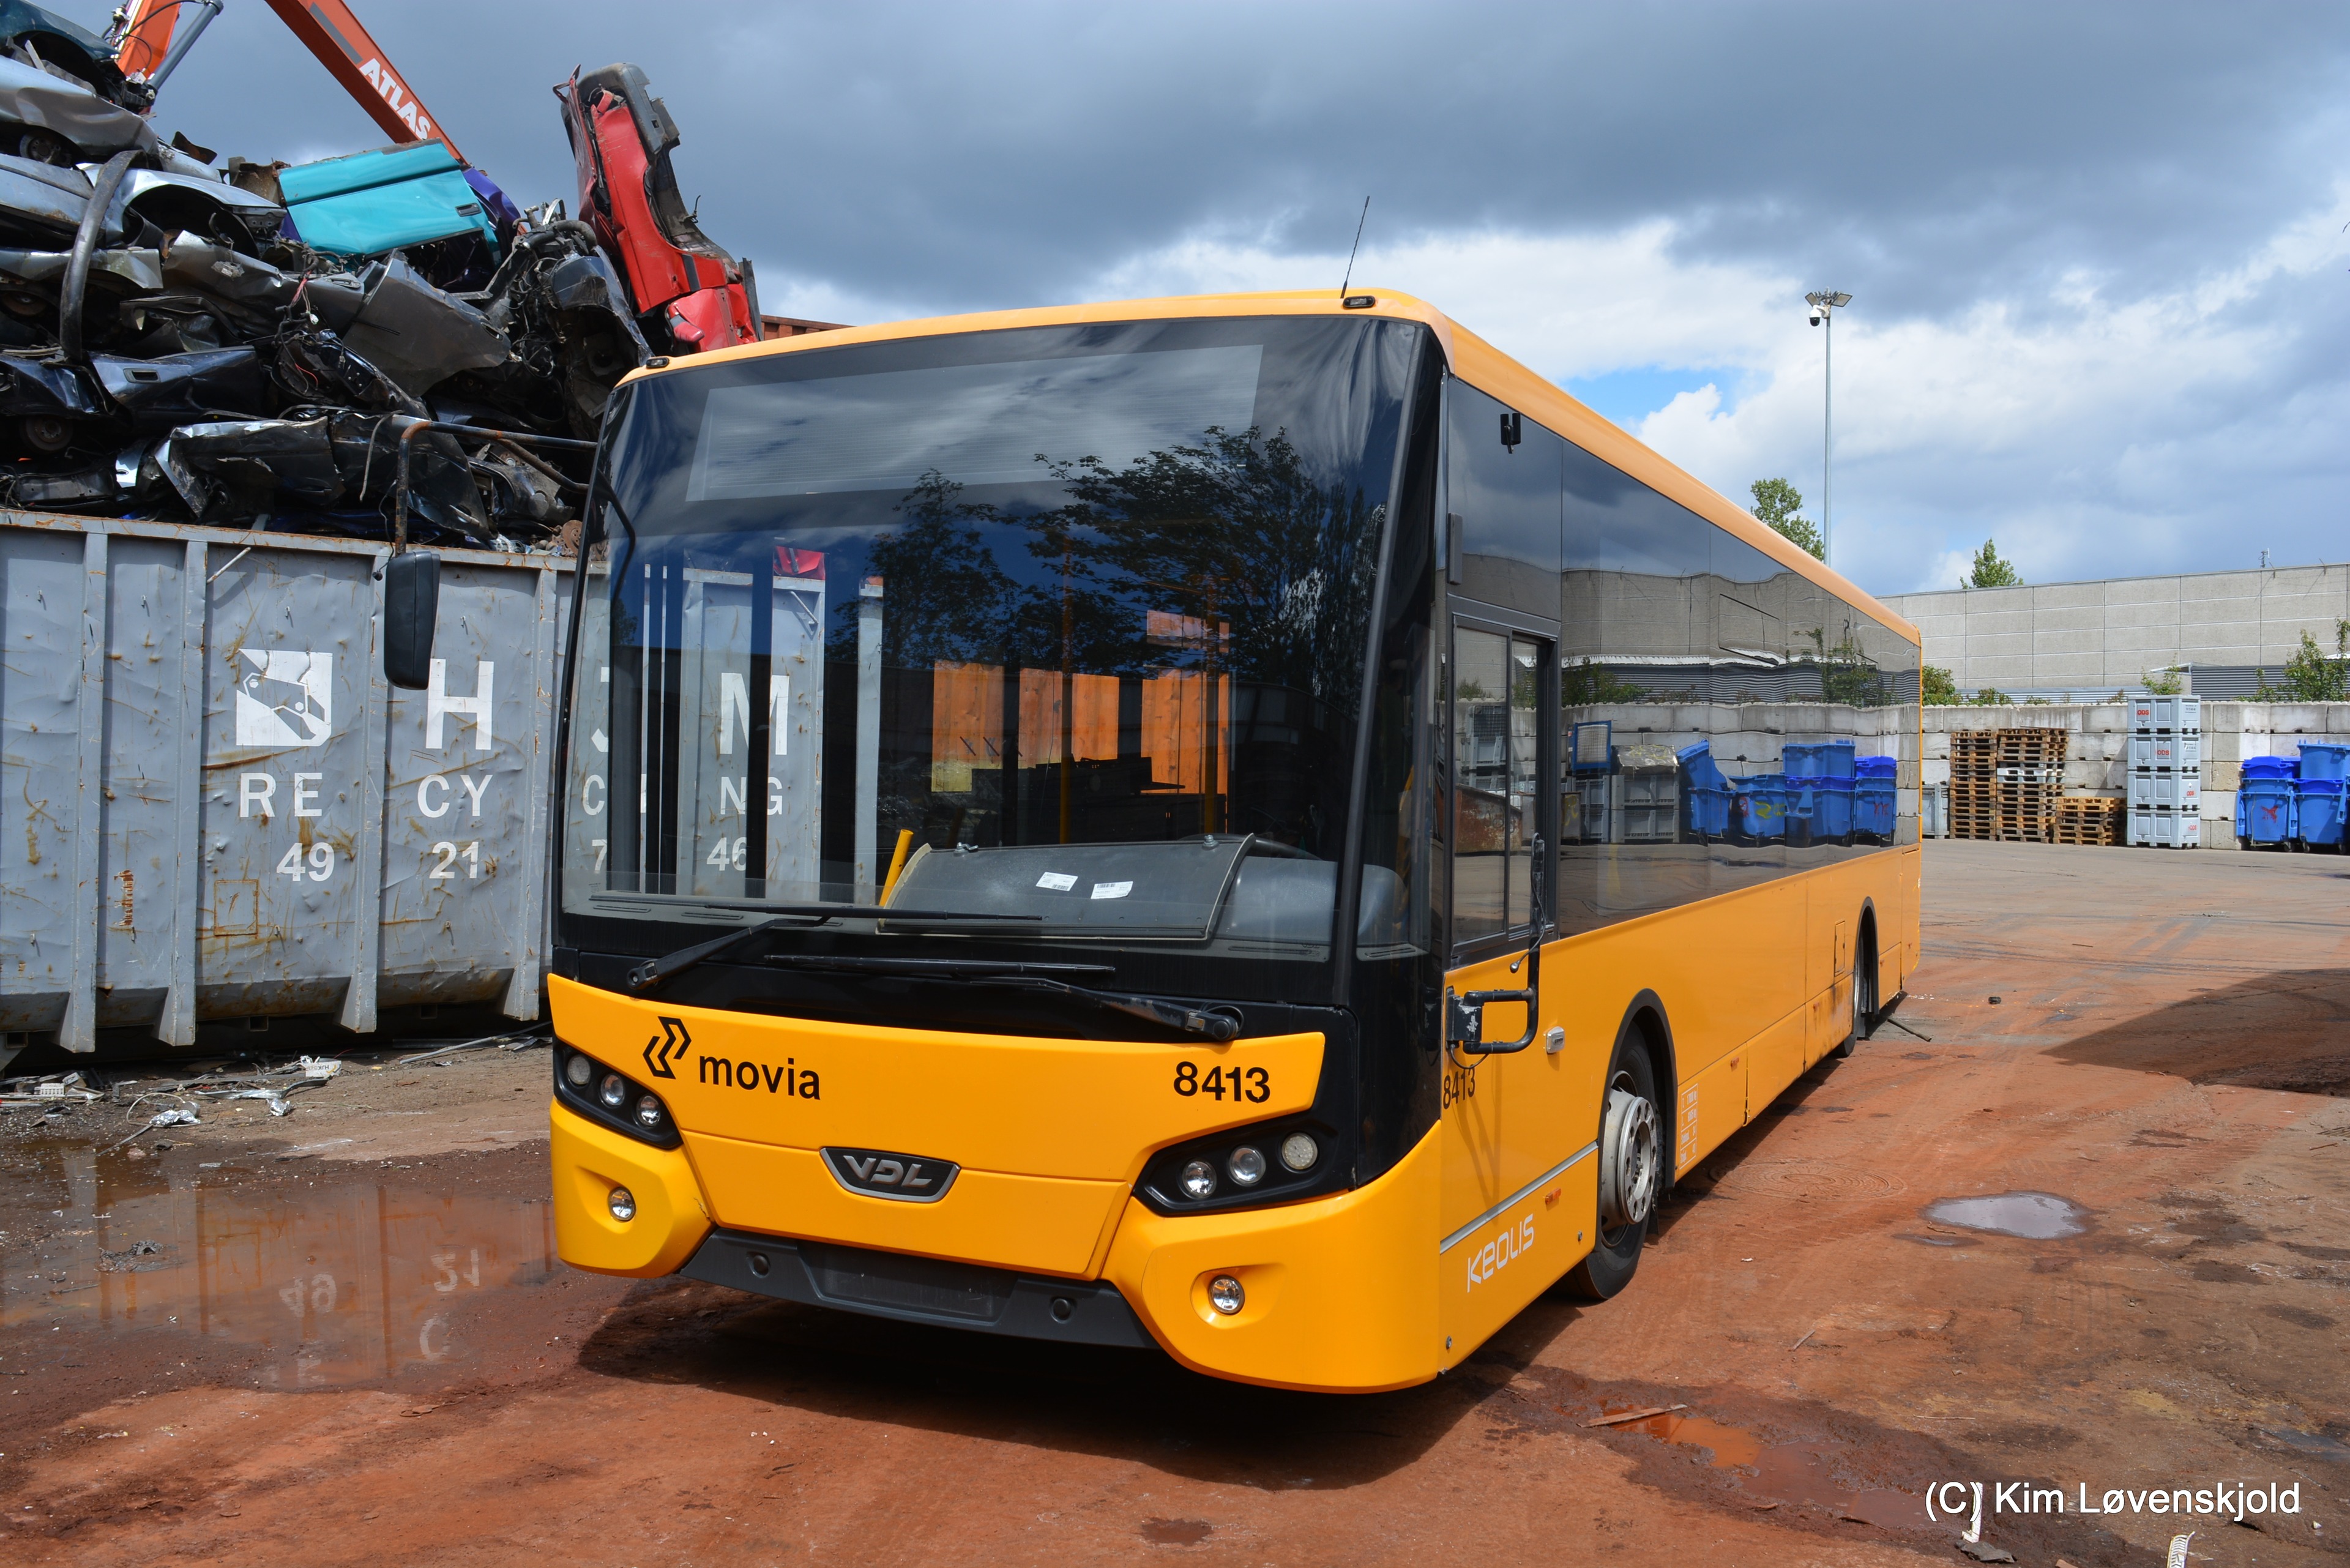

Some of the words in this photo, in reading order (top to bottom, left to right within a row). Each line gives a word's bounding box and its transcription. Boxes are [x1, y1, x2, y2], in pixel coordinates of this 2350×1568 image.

[359, 58, 431, 140] ATLAS
[276, 842, 335, 882] 49
[429, 842, 479, 879] 21
[707, 837, 747, 871] 46
[699, 1055, 821, 1100] movia
[1173, 1061, 1270, 1103] 8413
[1443, 1064, 1475, 1110] 8413
[843, 1155, 933, 1189] VDL
